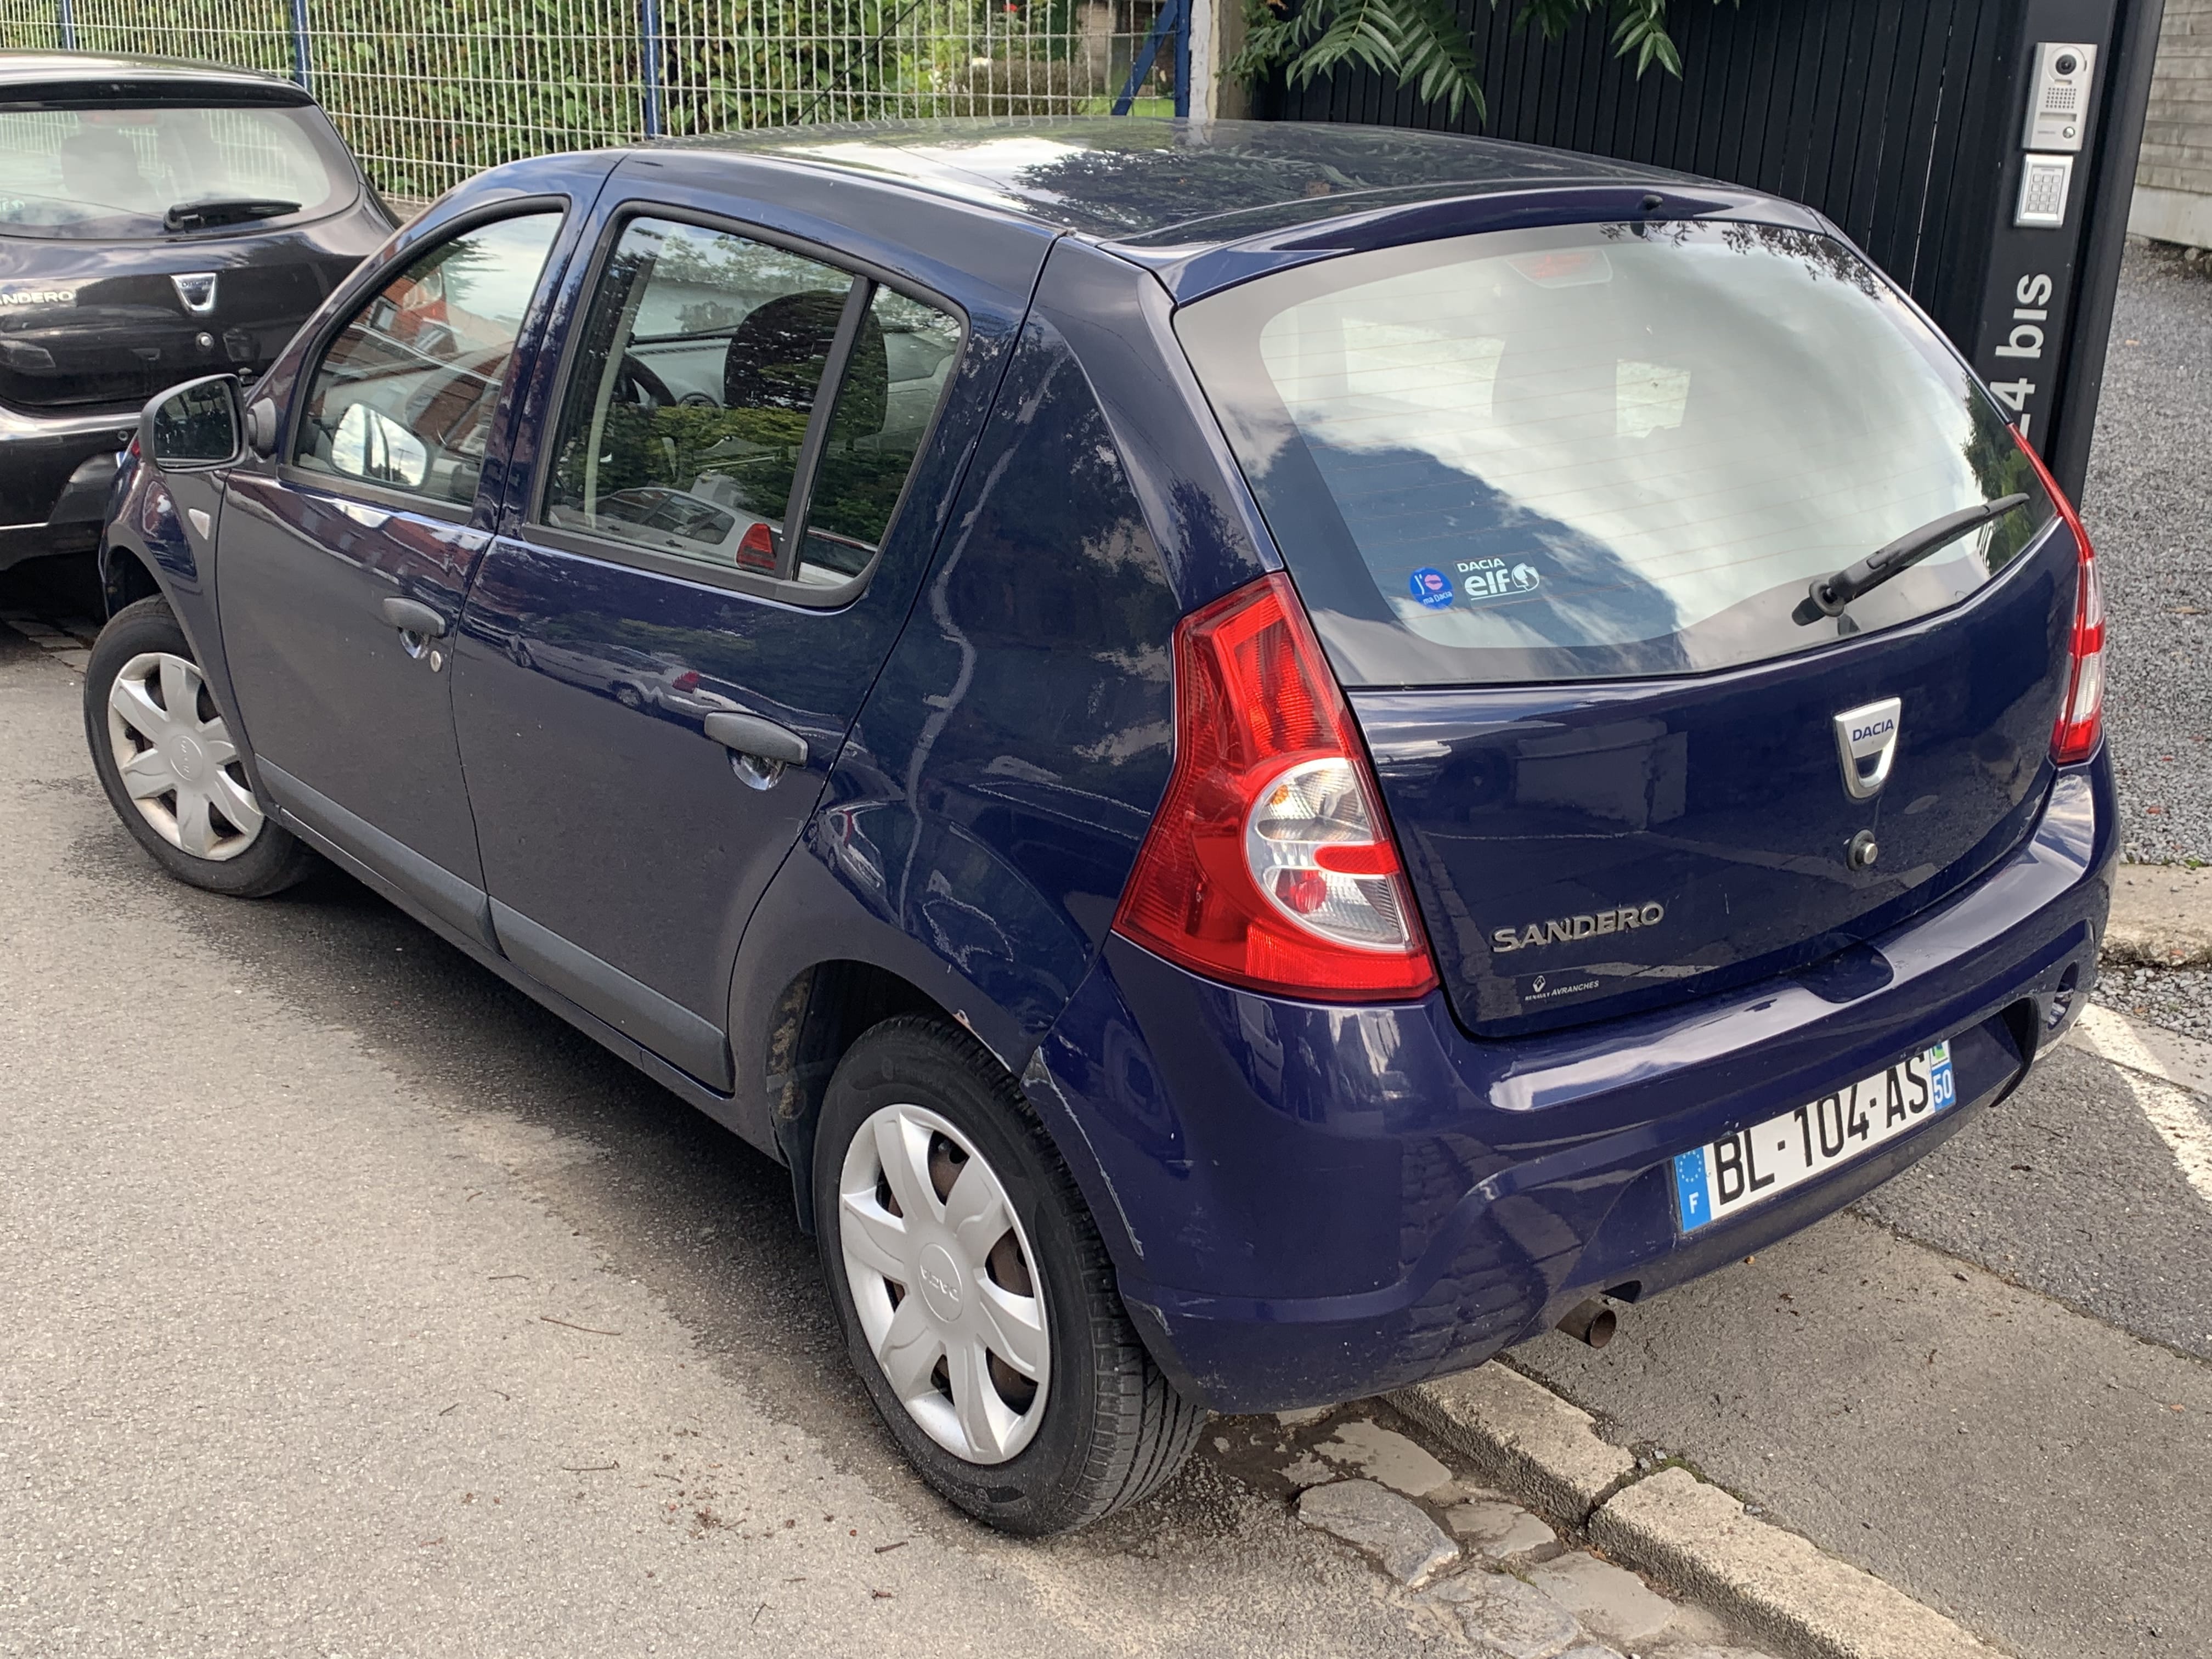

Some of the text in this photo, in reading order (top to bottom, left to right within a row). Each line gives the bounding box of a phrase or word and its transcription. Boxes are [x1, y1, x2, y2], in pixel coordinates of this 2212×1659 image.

[1995, 274, 2052, 358] bis
[1457, 558, 1505, 572] DACIA
[1464, 569, 1510, 596] elf
[1423, 591, 1453, 605] ma Dacia
[1852, 719, 1894, 742] DACIA
[1491, 900, 1664, 952] SANDERO
[1525, 980, 1599, 1001] RENAULT AVRANCHES
[1689, 1192, 1699, 1214] F
[1933, 1069, 1953, 1104] 50
